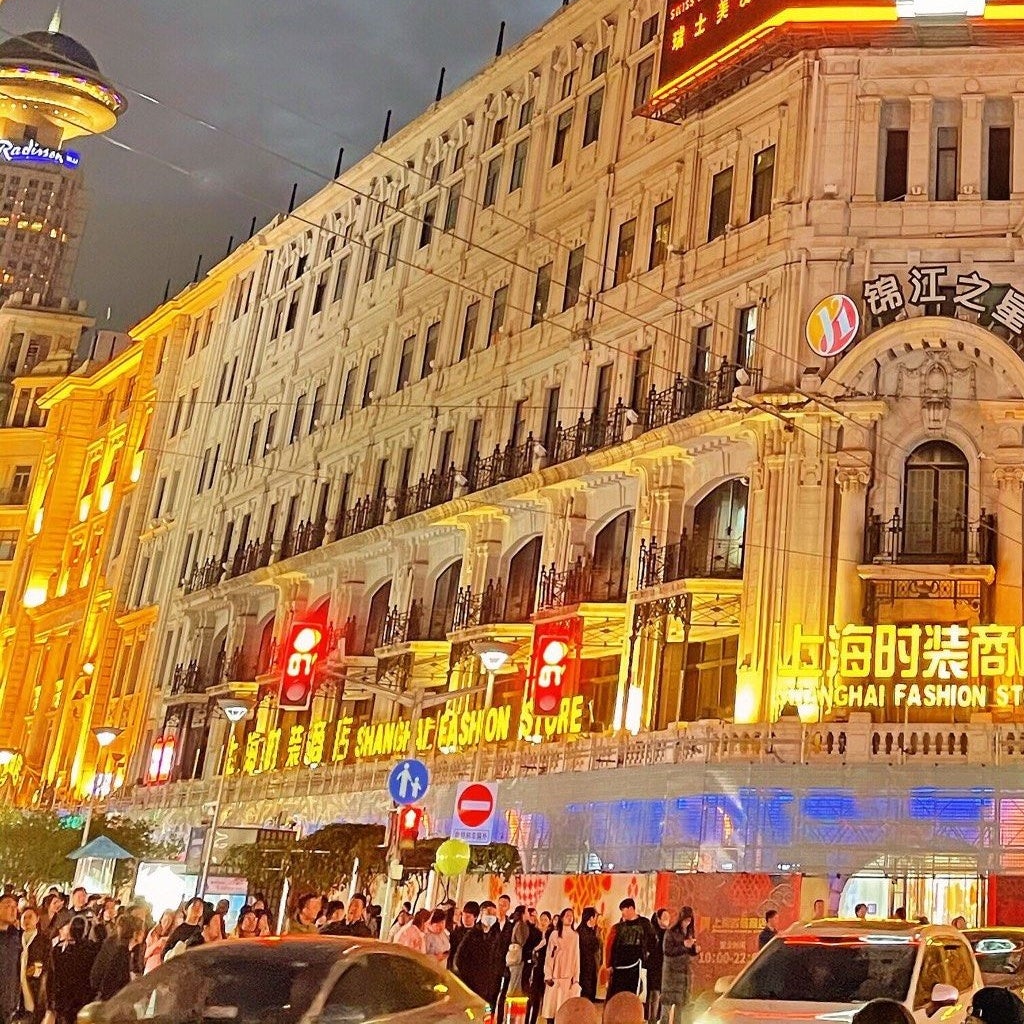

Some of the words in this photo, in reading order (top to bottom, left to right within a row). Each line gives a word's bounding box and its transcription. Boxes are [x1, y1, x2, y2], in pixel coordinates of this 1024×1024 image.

[0, 138, 64, 163] Radisson
[778, 683, 886, 708] NGHAI
[894, 683, 987, 708] FASHION
